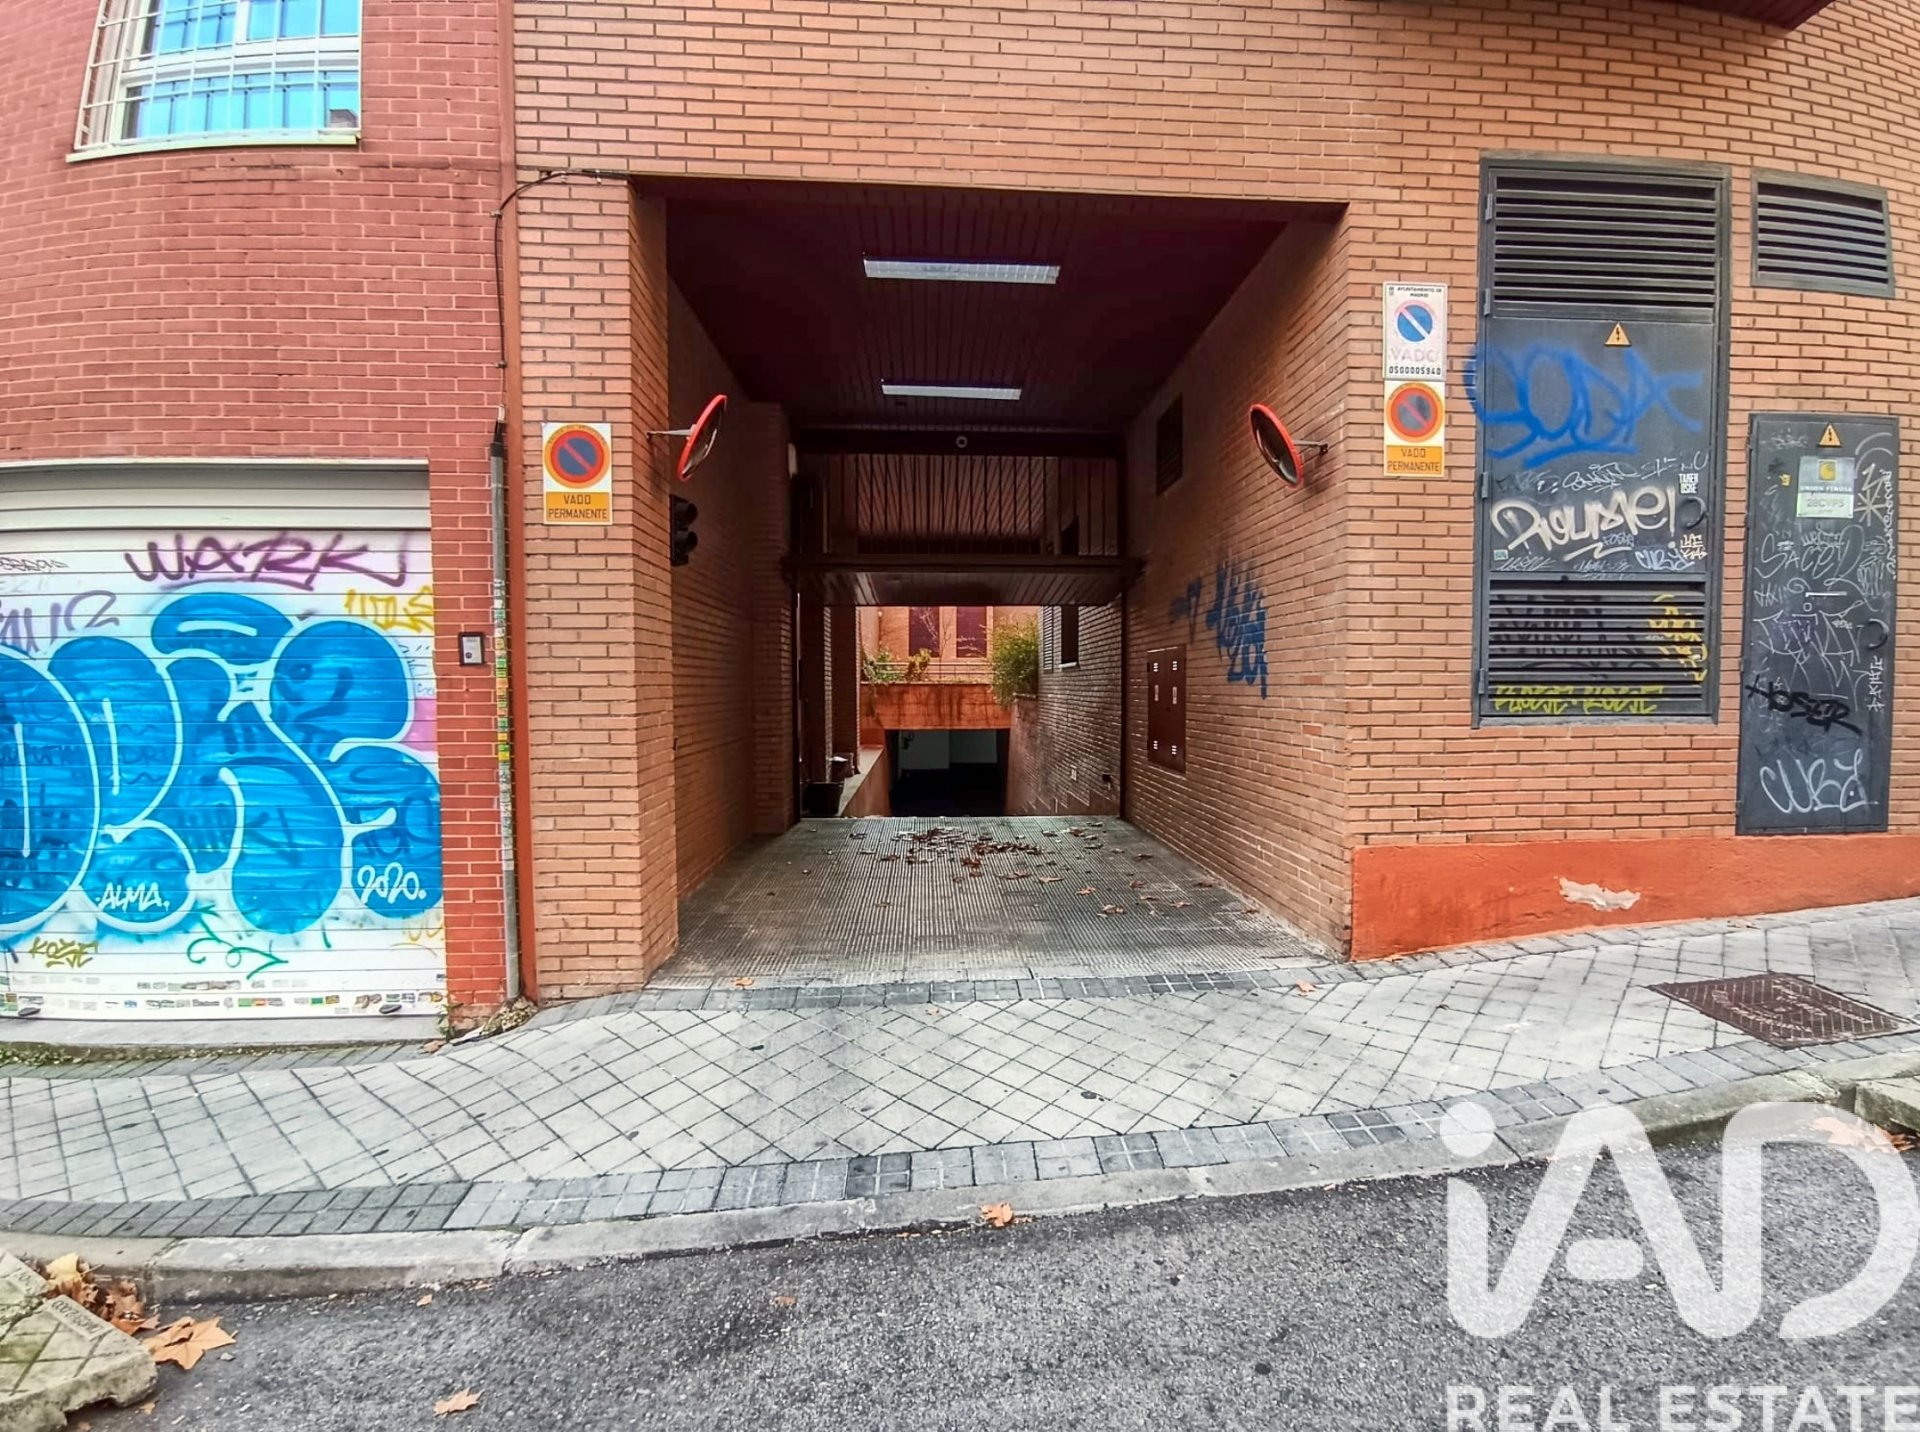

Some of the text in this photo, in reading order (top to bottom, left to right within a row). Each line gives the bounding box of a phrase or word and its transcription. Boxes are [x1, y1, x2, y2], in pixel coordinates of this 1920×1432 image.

[1401, 447, 1426, 458] VADO
[1387, 460, 1440, 472] PERMANENTE
[563, 494, 592, 505] VADO
[548, 508, 608, 519] PERMANENTE
